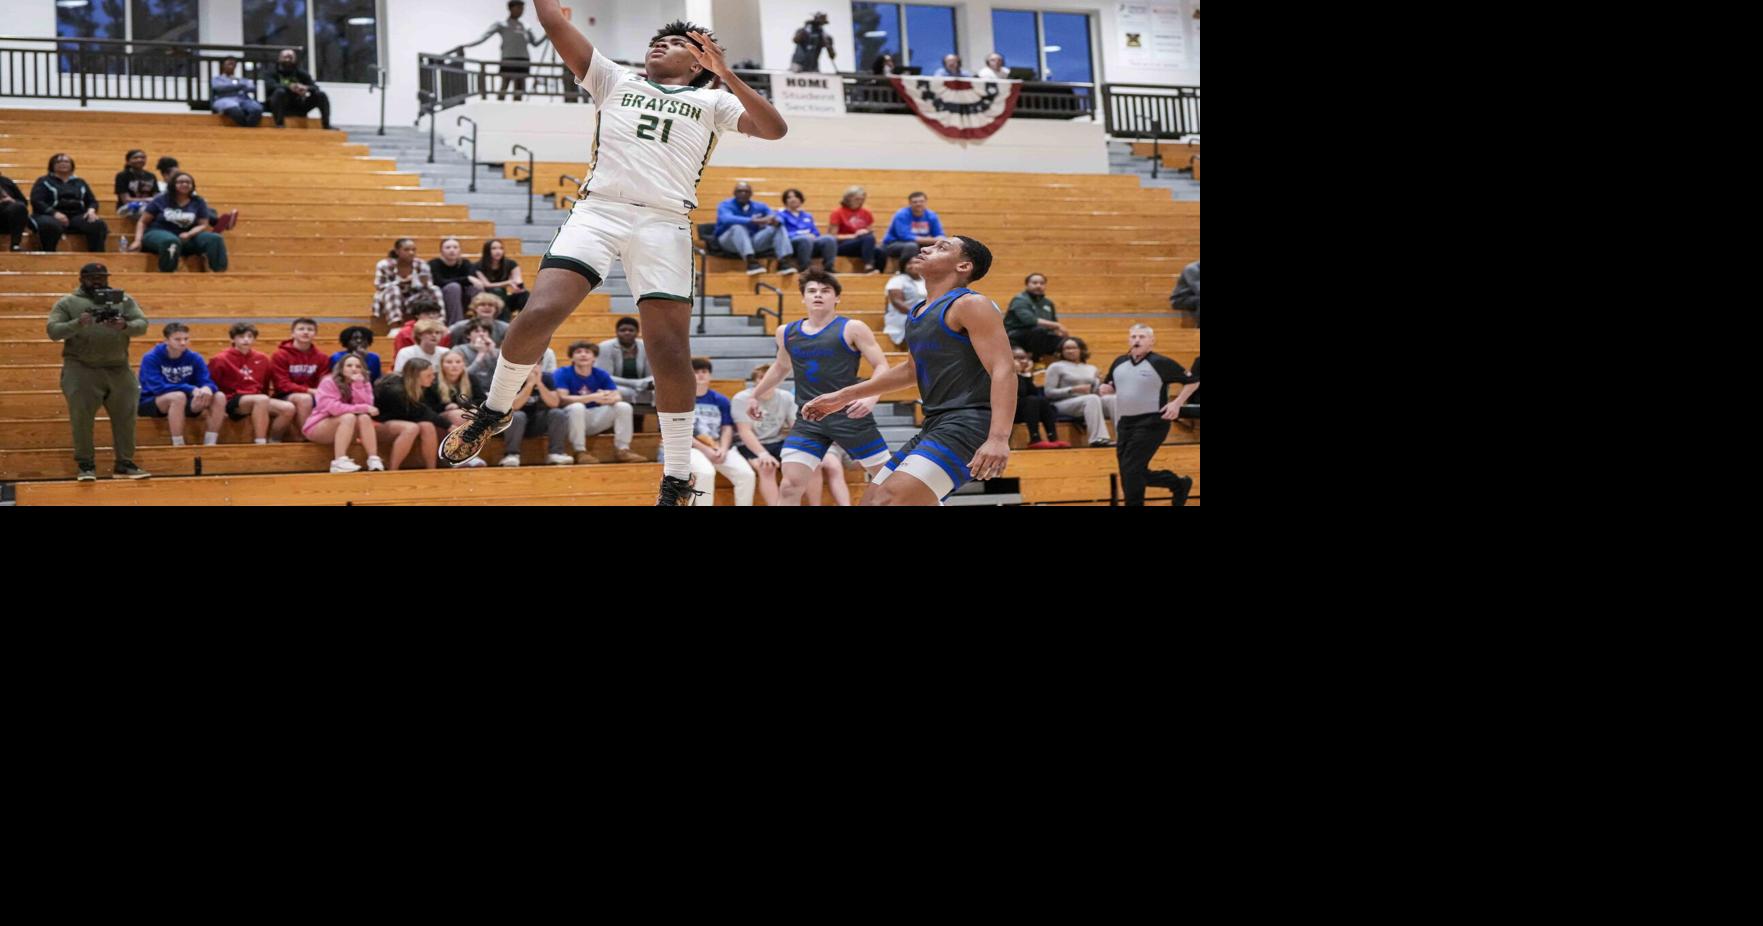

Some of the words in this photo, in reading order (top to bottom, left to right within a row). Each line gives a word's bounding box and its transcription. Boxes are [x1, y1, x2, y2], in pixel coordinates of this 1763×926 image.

[786, 78, 829, 89] HOME
[621, 93, 702, 121] GRAYSON
[636, 113, 674, 144] 21
